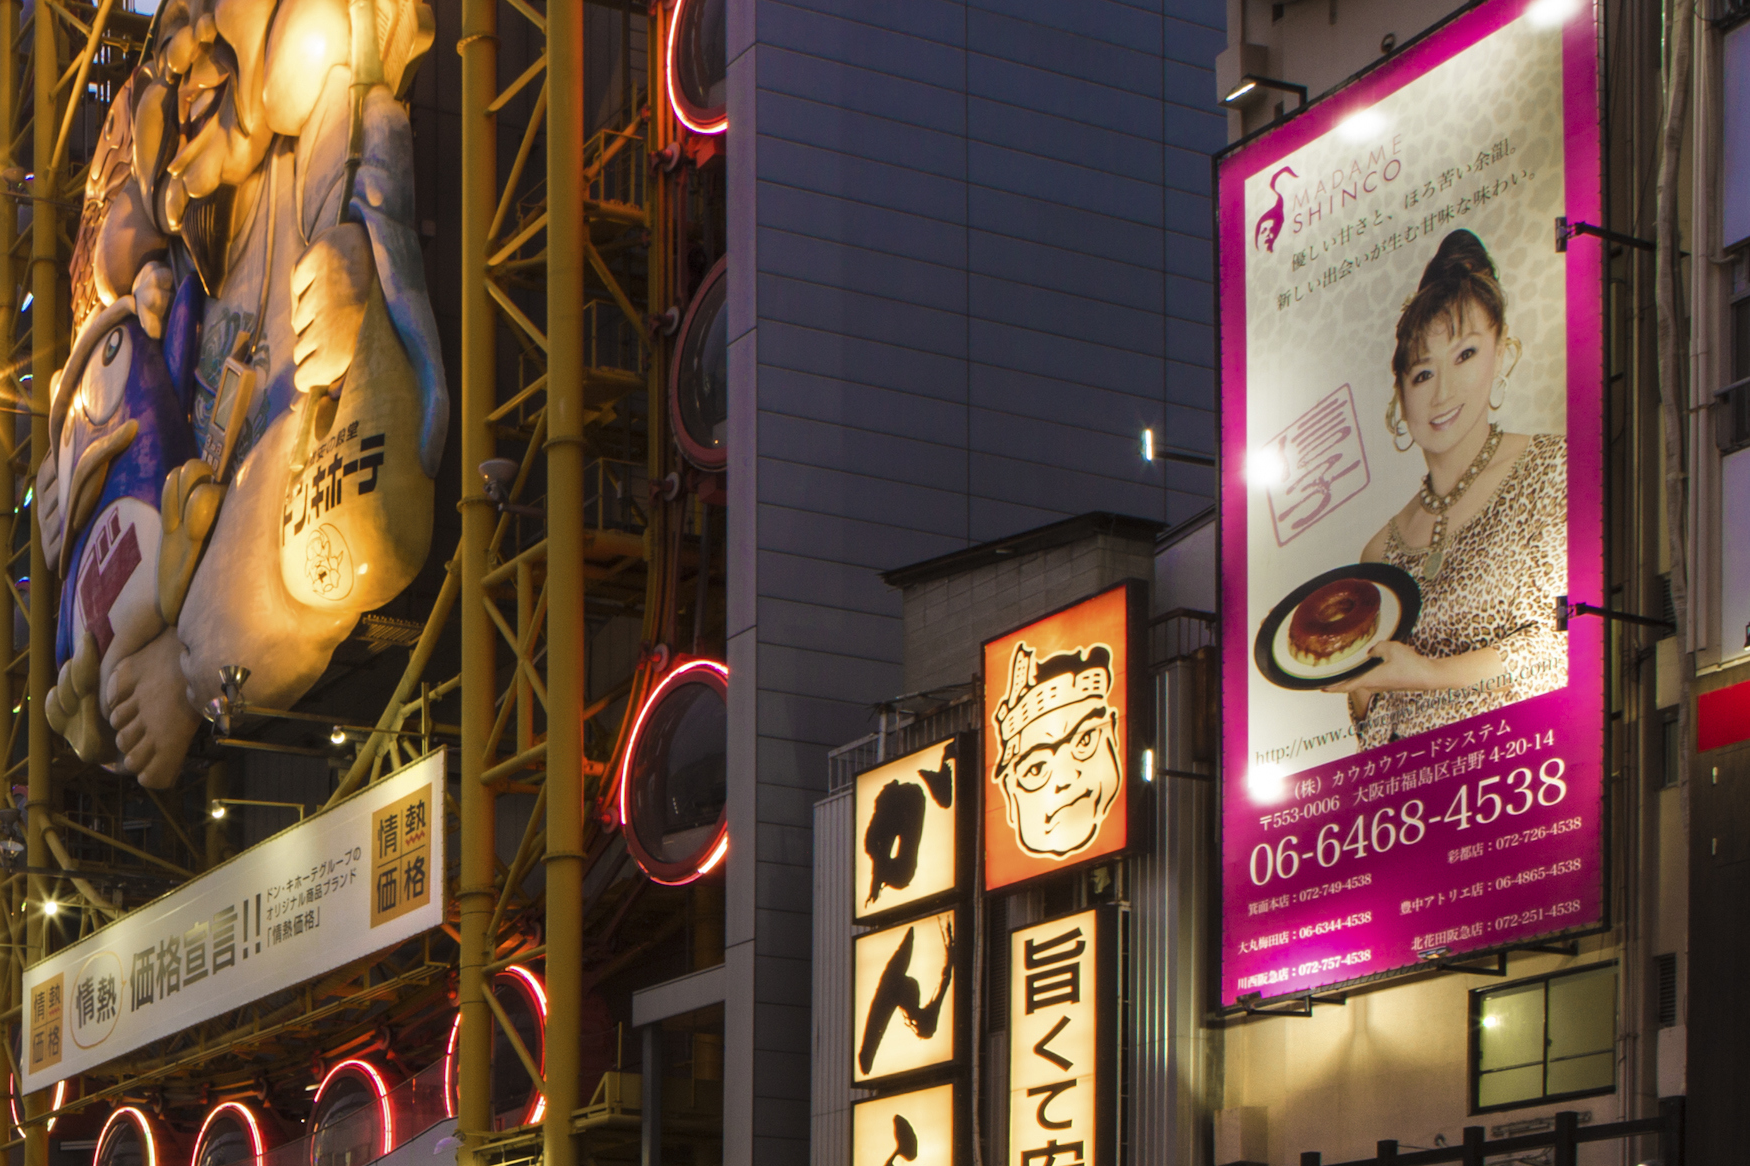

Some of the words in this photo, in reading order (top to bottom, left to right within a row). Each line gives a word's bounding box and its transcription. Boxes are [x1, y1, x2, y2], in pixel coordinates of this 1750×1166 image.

[1292, 134, 1402, 213] MADAME
[1293, 158, 1402, 235] SHINCO
[1352, 749, 1486, 806] 大阪市福島区吉野
[1488, 730, 1555, 763] 4-20-14
[377, 798, 427, 860] 情熱
[1249, 757, 1567, 887] 06-6468-4538
[266, 846, 362, 904] ドン・キホーテグループの
[266, 866, 357, 921] オリジナル商品ブランド
[376, 856, 427, 915] 価格
[266, 905, 321, 948] 「情熱価格」
[75, 971, 117, 1030] 情熱
[129, 893, 262, 1013] 価格宣言!!
